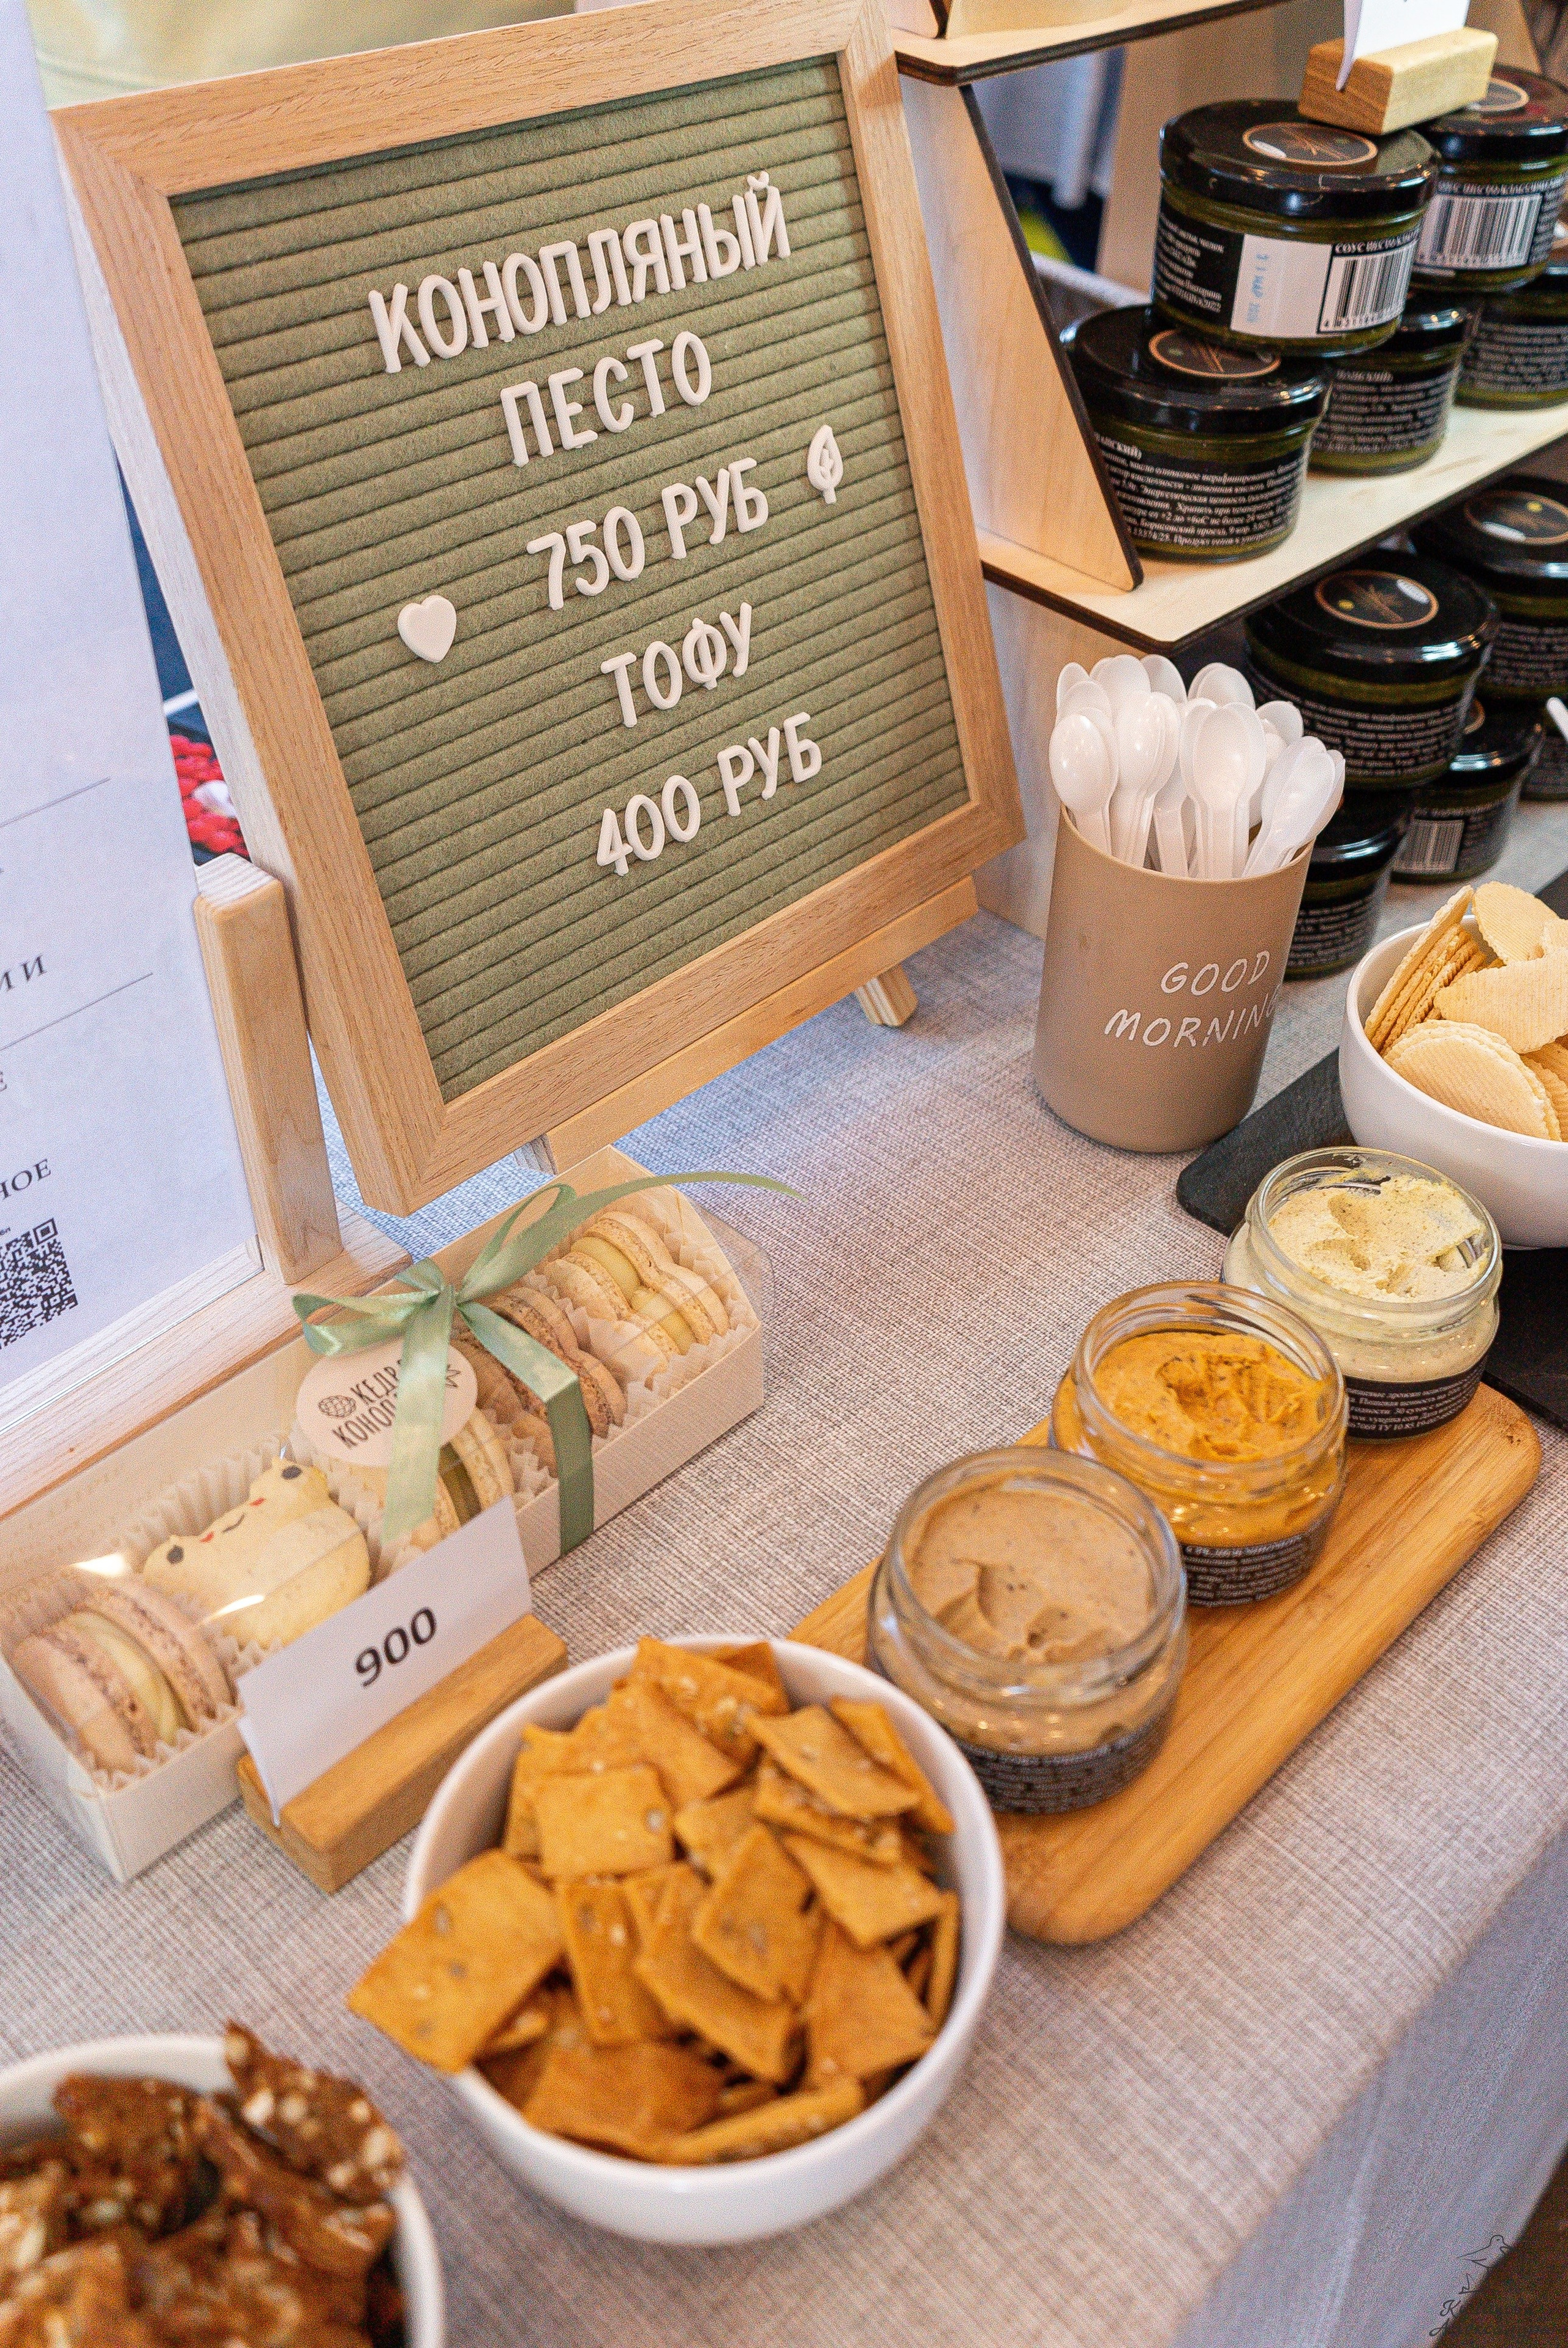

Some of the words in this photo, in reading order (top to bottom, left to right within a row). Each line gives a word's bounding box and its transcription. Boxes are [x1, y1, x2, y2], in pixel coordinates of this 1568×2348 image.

[369, 171, 791, 373] КОНОПЛЯНЫЙ
[500, 331, 712, 467] ПЕСТО
[527, 506, 646, 610] 750
[662, 458, 769, 559] РУБ
[601, 602, 752, 727] ТОФУ
[597, 774, 701, 876] 400
[717, 712, 822, 816] РУБ
[1161, 950, 1270, 996] GOOD
[333, 1394, 398, 1449] КОНОП
[350, 1359, 401, 1405] КЕДР
[355, 1607, 437, 1686] 900
